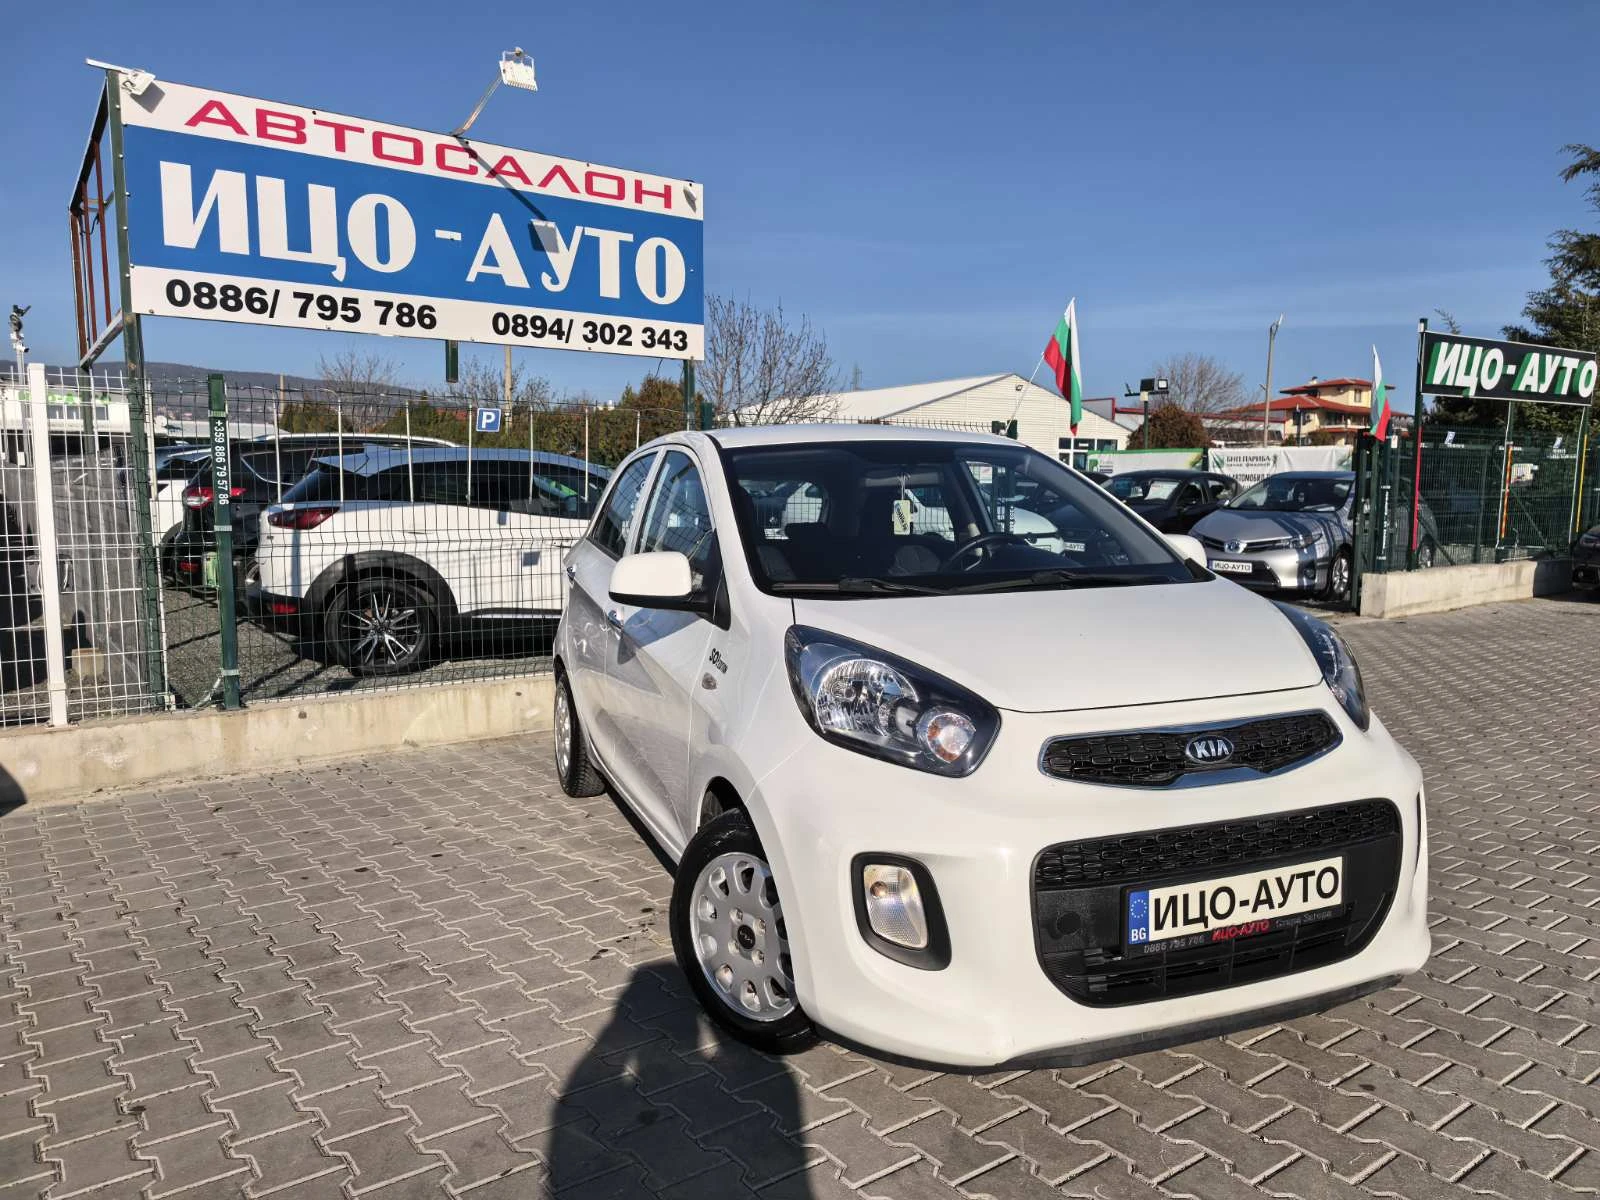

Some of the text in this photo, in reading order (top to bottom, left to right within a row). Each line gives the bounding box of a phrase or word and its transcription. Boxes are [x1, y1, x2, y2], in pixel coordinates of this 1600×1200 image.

[184, 100, 672, 209] АВТОСАЛОН
[166, 278, 688, 351] 0886/ 795 786 0894/ 302 343
[481, 411, 496, 429] P
[213, 420, 229, 505] +359 886 79 57 86
[1193, 739, 1230, 758] KIA
[1154, 866, 1340, 931] ИЦО-АУТО
[1131, 927, 1146, 941] BG
[1211, 918, 1272, 941] ИЦО-АУТО
